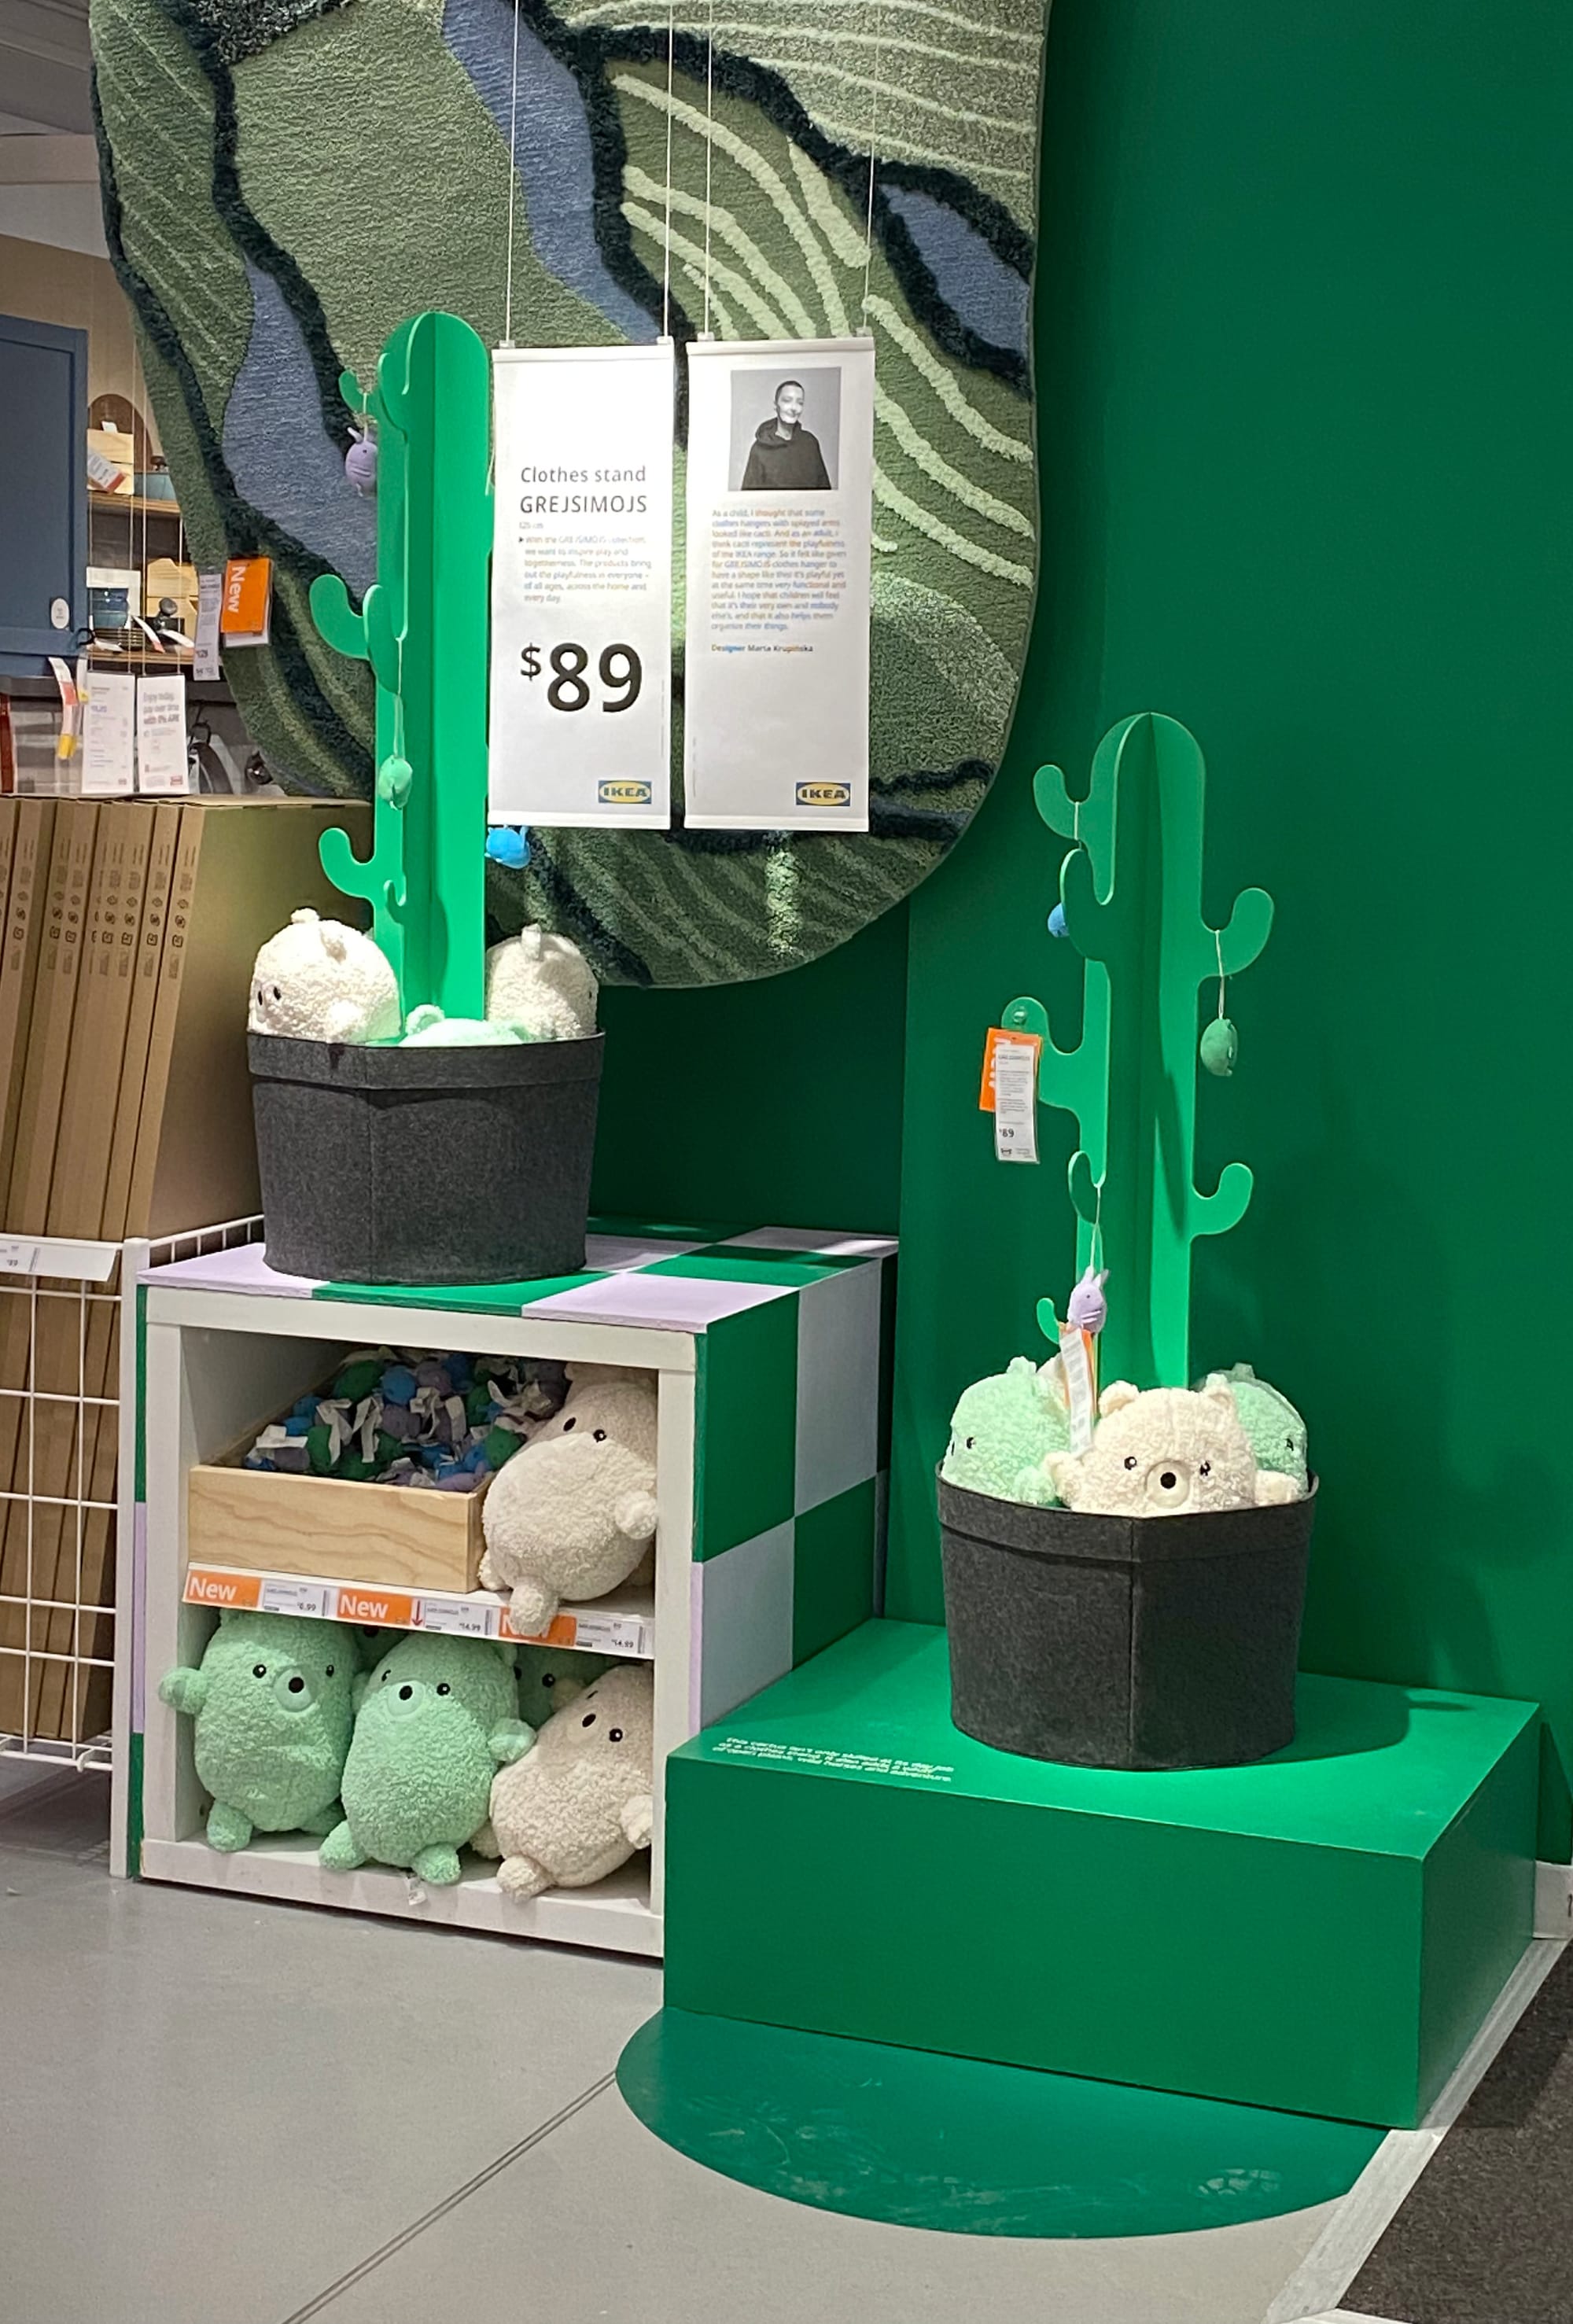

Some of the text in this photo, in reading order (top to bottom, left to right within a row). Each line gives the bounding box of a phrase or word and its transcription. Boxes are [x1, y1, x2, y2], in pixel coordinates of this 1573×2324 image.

[521, 466, 647, 483] Clothes stand
[520, 495, 647, 514] GREJSIMOJS
[227, 566, 246, 613] New
[712, 644, 745, 653] Designer
[521, 643, 642, 713] $89
[603, 786, 647, 797] IKEA
[801, 789, 846, 799] IKEA
[189, 1576, 238, 1601] New
[339, 1593, 389, 1619] New
